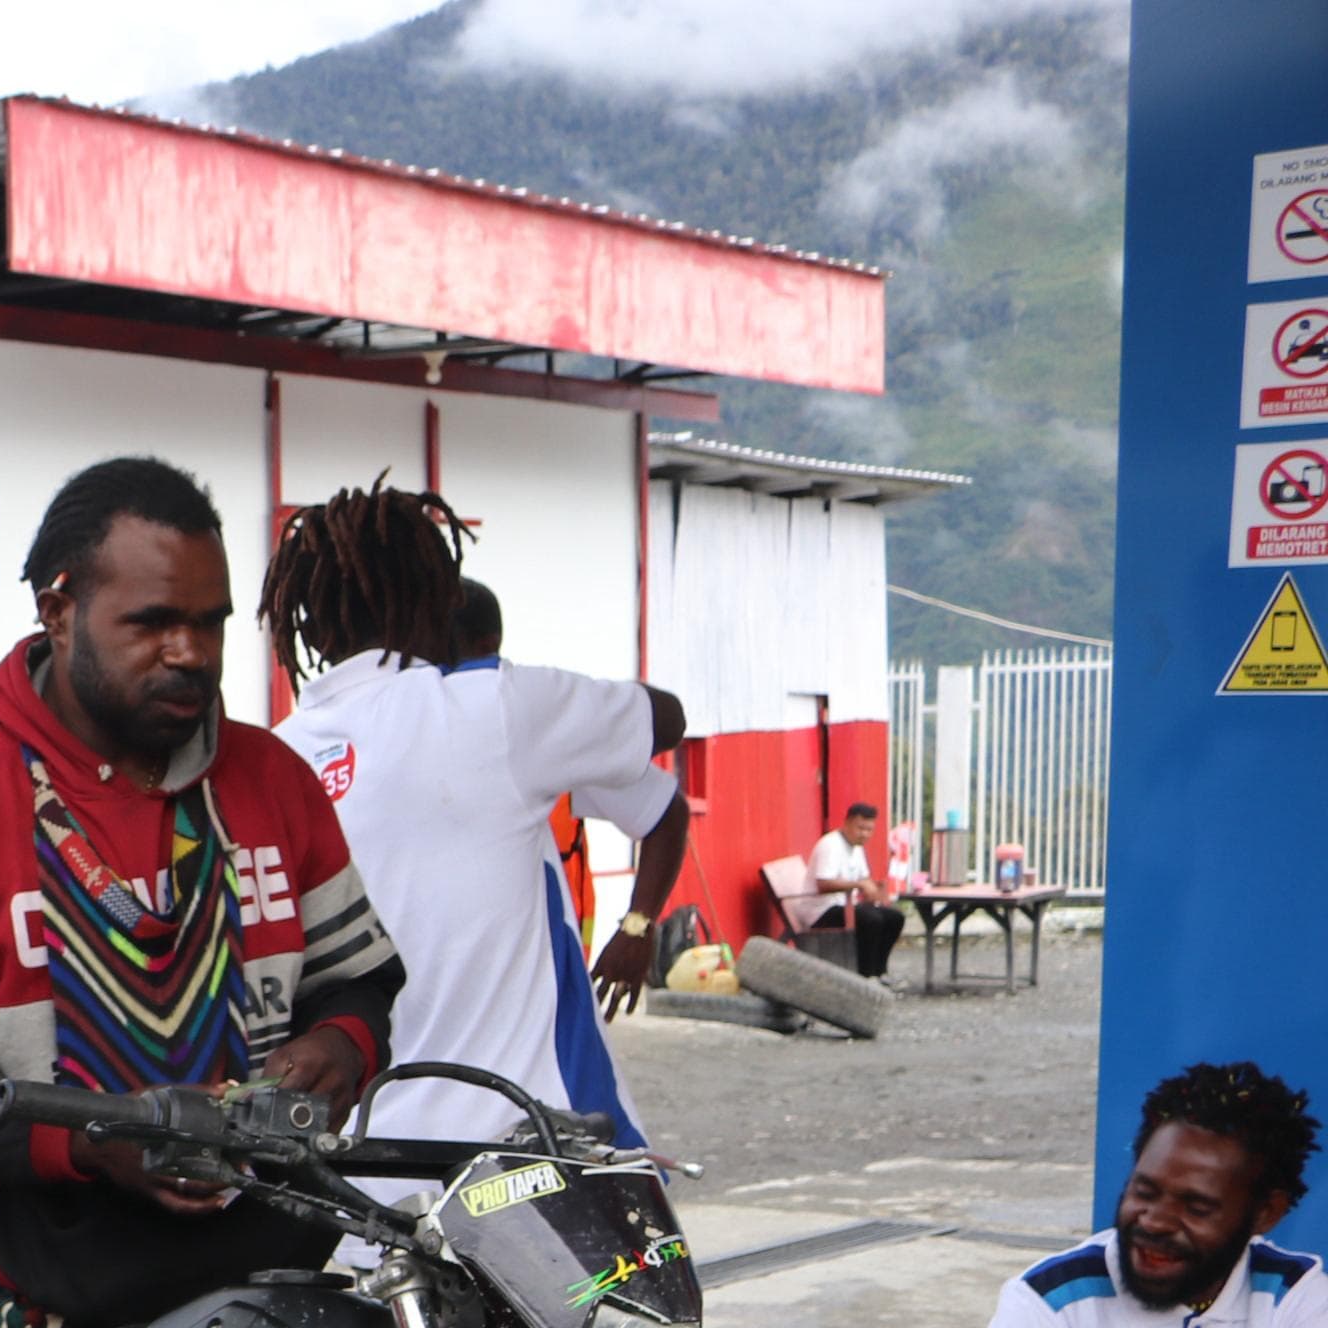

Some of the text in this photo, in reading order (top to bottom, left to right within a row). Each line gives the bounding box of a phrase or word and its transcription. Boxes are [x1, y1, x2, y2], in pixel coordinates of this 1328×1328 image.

[1260, 172, 1317, 189] DILARANG
[1260, 525, 1326, 542] DILARANG
[1256, 541, 1328, 556] MEMOTRET
[468, 1165, 559, 1214] PROTAPER
